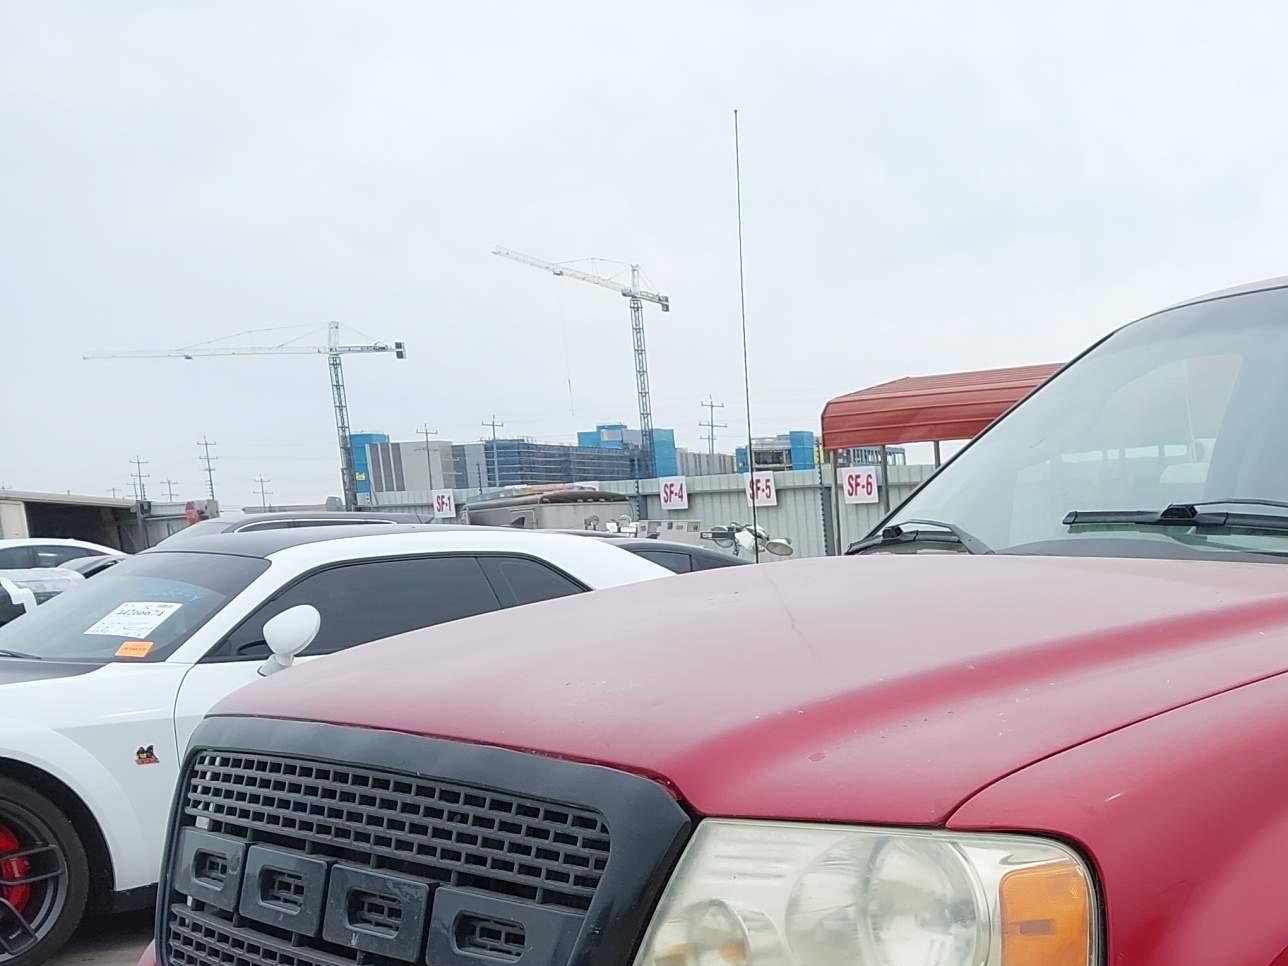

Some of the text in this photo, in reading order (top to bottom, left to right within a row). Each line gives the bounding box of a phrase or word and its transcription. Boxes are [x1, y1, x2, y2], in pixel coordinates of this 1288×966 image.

[664, 484, 684, 502] SF-4
[749, 479, 771, 500] SF-5
[848, 474, 873, 496] SF-6
[437, 495, 451, 512] SF-1
